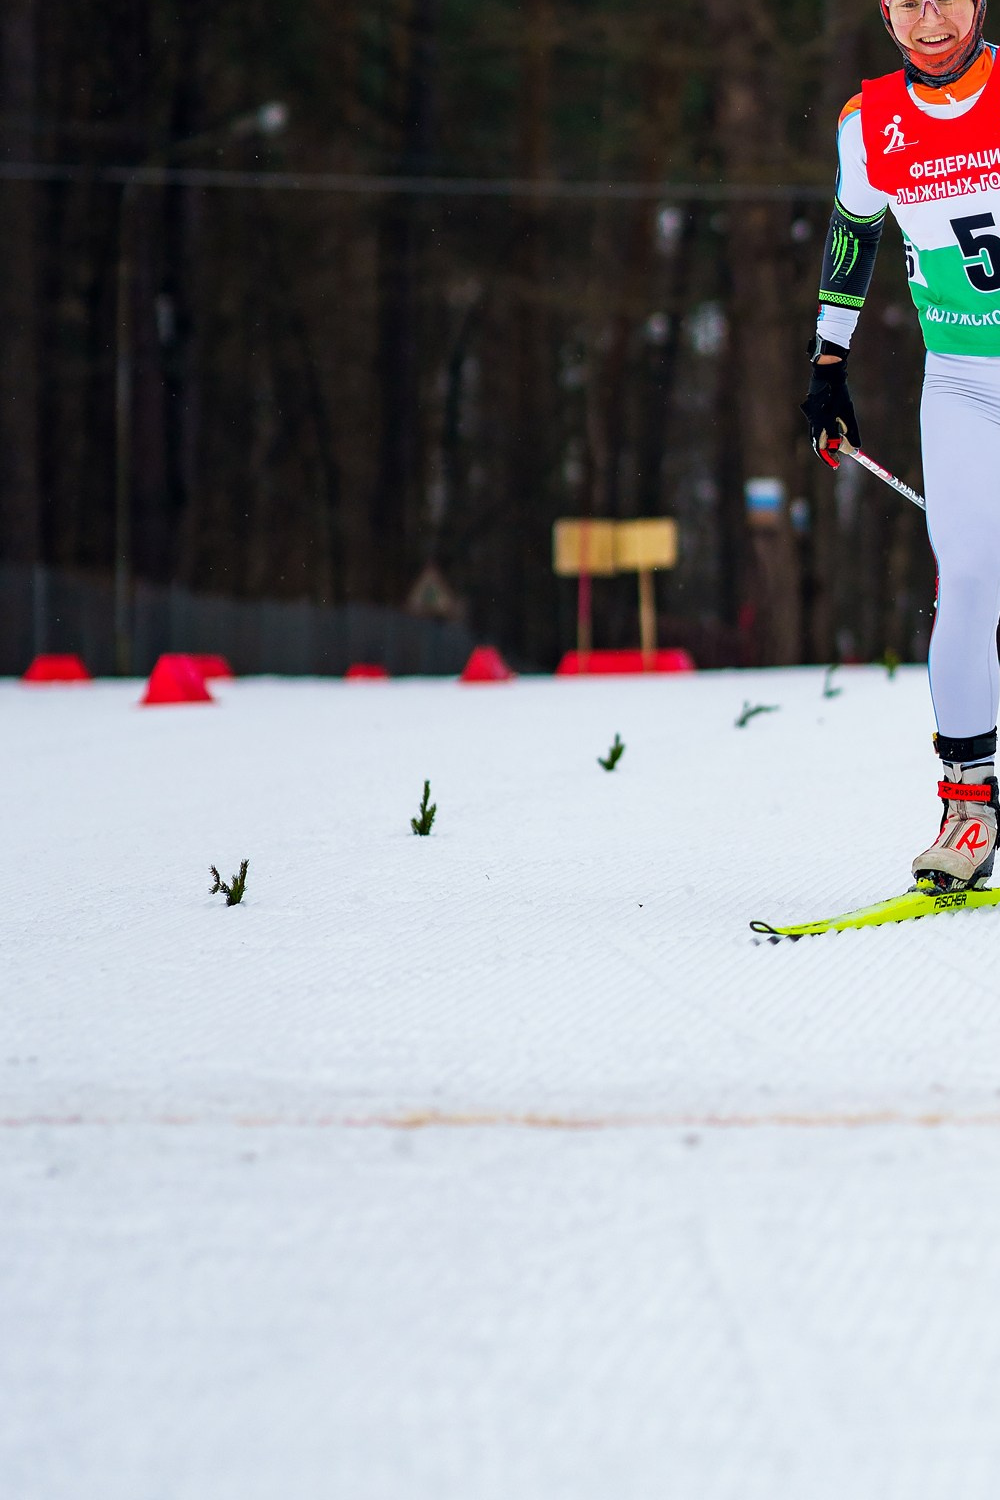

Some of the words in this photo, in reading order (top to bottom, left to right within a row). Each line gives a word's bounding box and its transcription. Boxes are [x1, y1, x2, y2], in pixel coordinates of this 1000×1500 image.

[896, 176, 977, 204] ЛЫЖНЫХ
[955, 822, 988, 858] R
[933, 893, 968, 909] FISCHER
